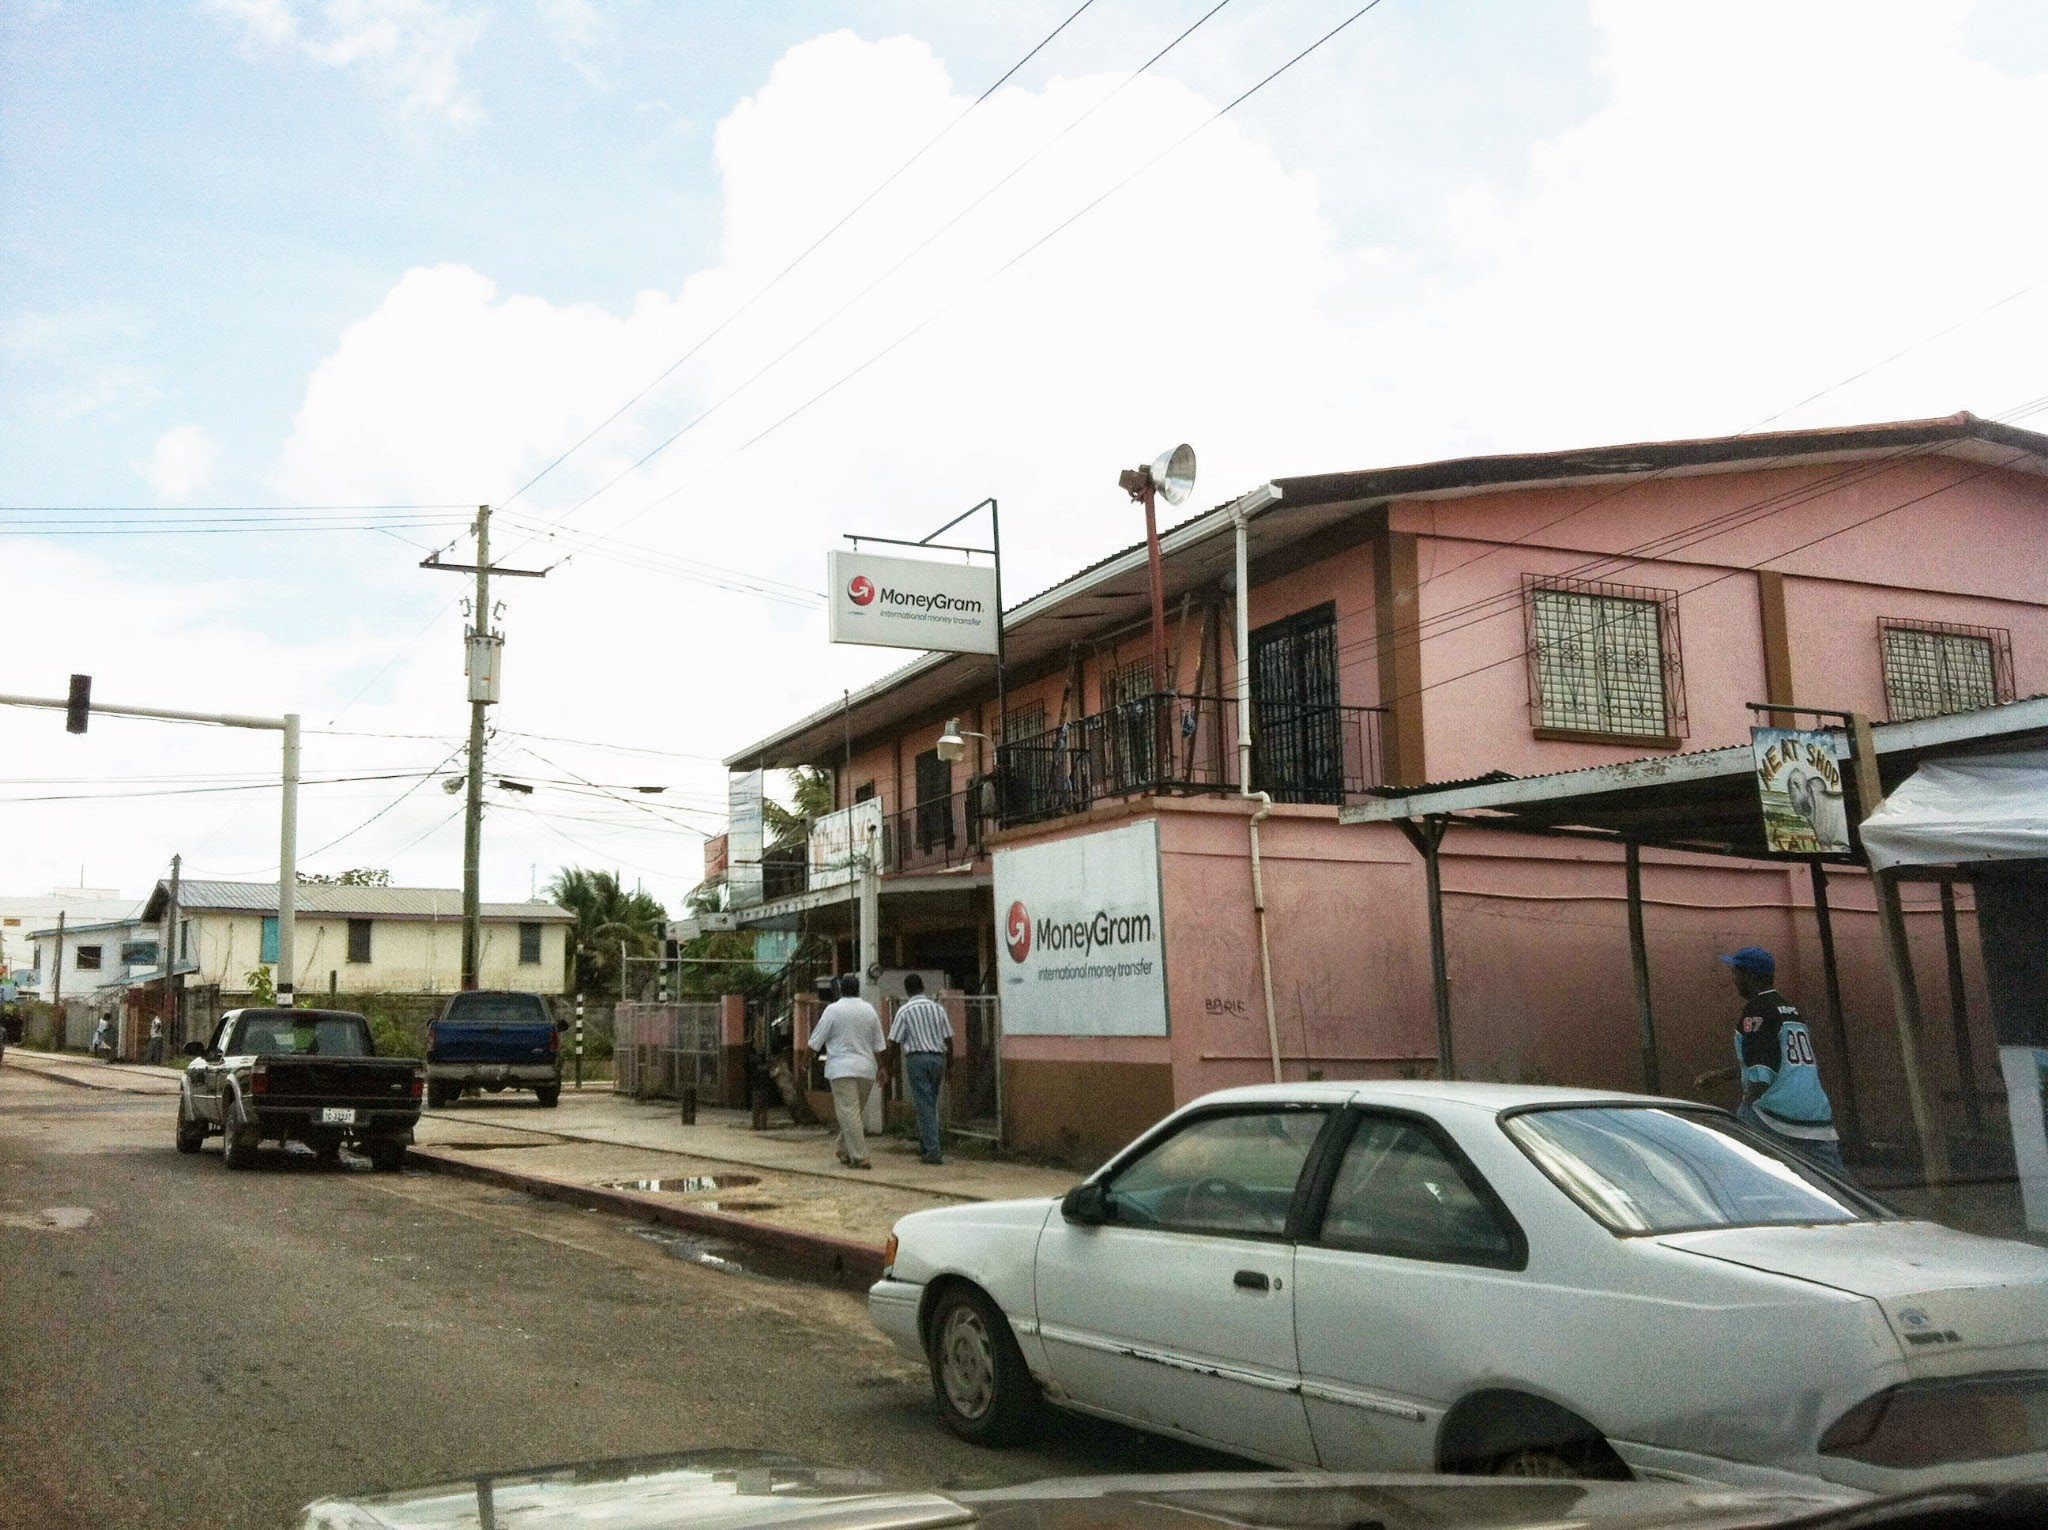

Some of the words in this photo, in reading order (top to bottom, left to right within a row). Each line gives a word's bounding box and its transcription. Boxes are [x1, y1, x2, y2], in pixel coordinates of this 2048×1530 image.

[879, 588, 982, 613] MoneyGram
[880, 610, 927, 622] international
[927, 614, 953, 625] money
[953, 616, 982, 627] transfer
[1806, 743, 1839, 788] SHOP
[1036, 911, 1152, 957] MoneyGram
[1038, 962, 1087, 981] international
[1087, 964, 1117, 981] money
[1117, 958, 1152, 977] transfer
[1787, 1029, 1815, 1065] 80
